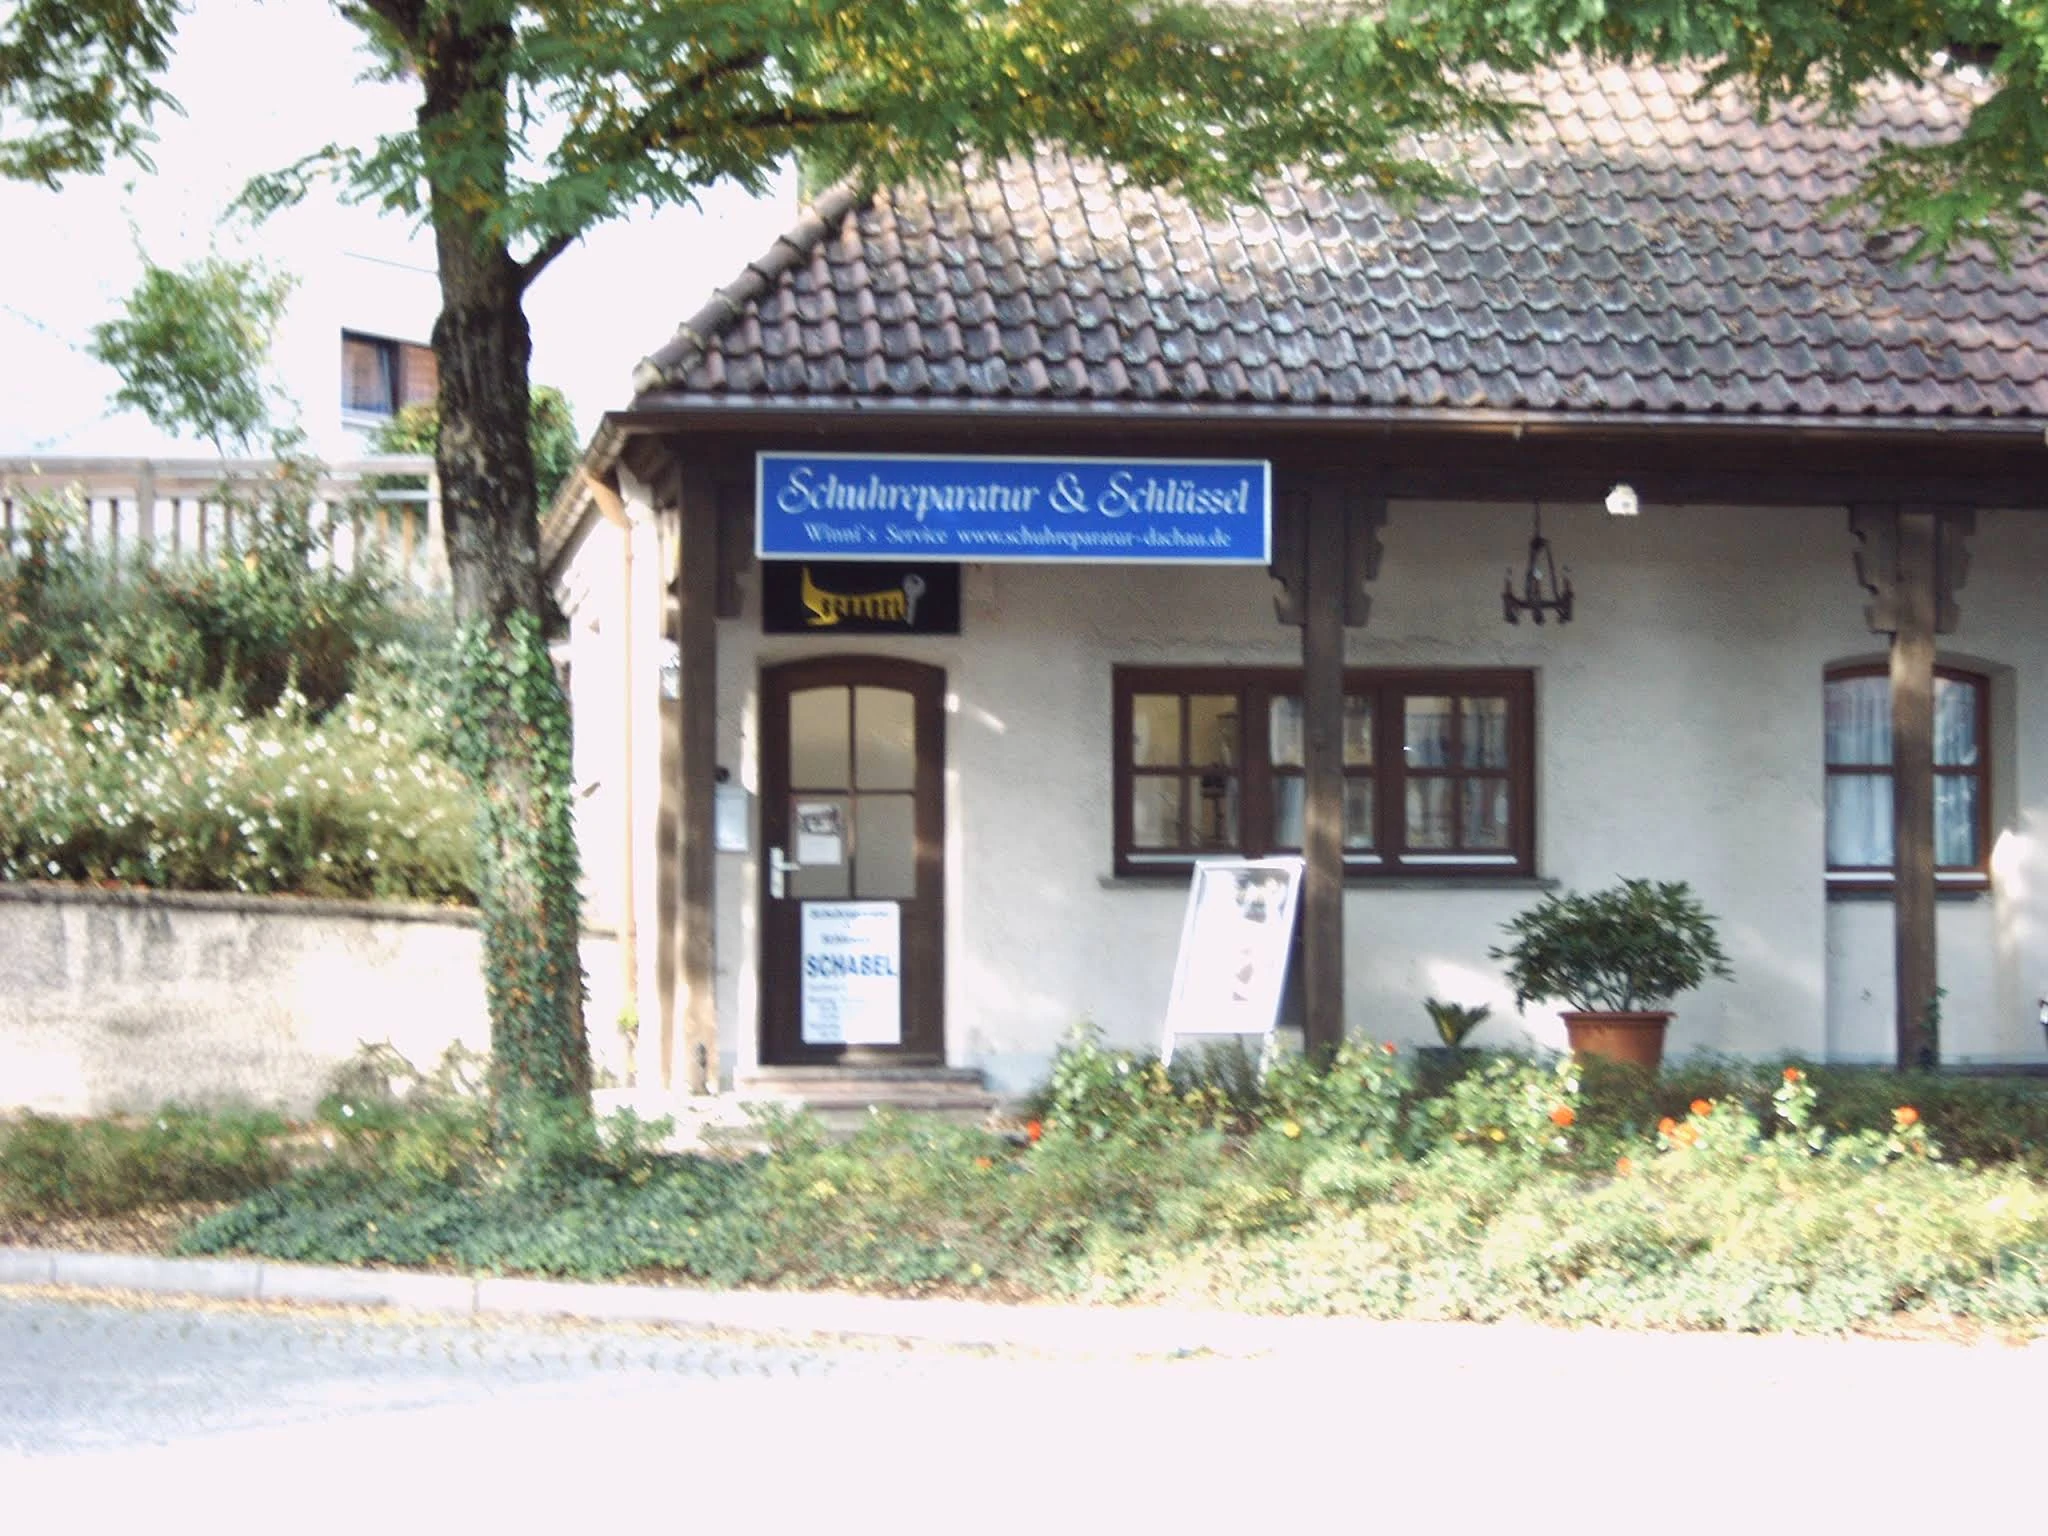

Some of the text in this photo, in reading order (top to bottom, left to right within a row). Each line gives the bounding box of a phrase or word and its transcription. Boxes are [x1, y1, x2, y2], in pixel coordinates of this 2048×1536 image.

[776, 466, 1250, 521] Schuhreparatur & Schlüssel
[885, 522, 948, 544] Service
